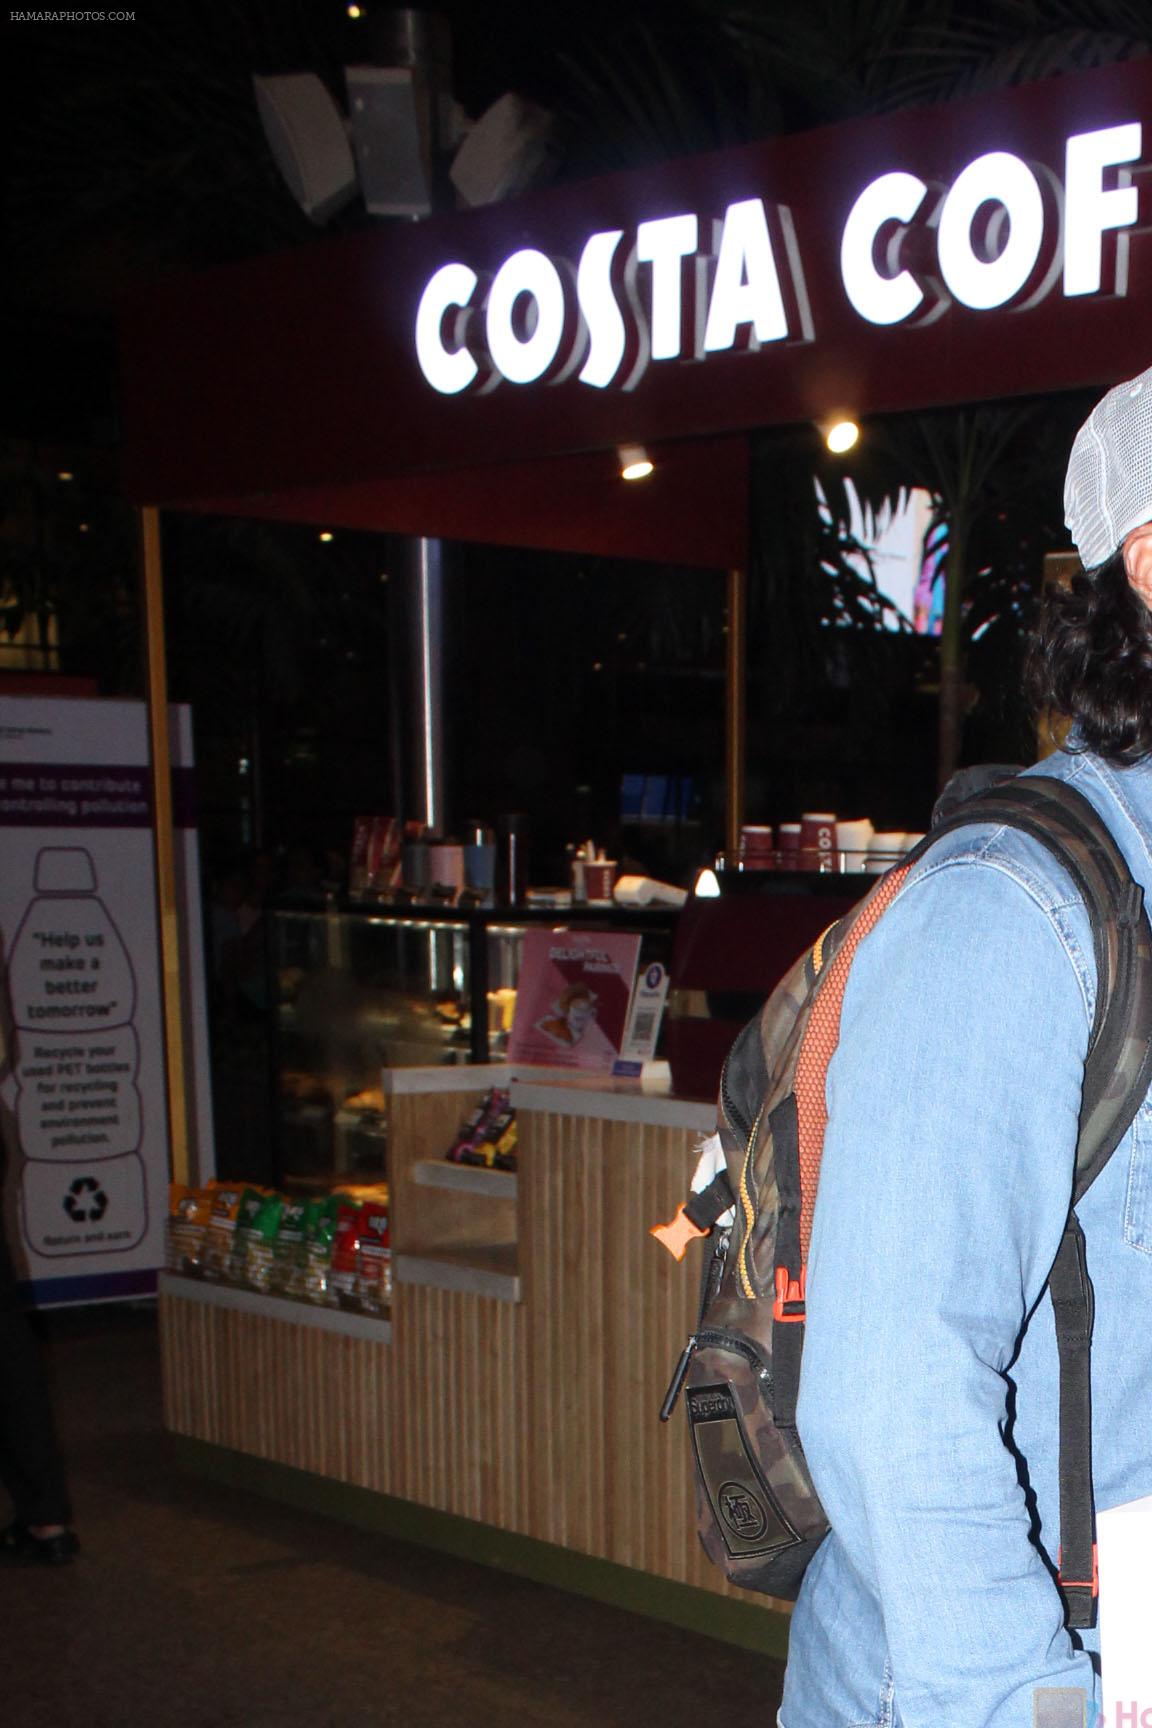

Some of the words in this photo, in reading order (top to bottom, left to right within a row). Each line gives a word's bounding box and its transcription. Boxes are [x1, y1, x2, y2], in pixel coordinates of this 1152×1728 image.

[415, 197, 790, 396] COSTA
[33, 931, 80, 950] "Help
[85, 932, 104, 947] us
[40, 956, 85, 972] make
[91, 959, 100, 971] a
[45, 978, 98, 996] better
[27, 1001, 118, 1019] tomorrow"
[34, 1045, 84, 1062] Recycle
[88, 1045, 117, 1060] your
